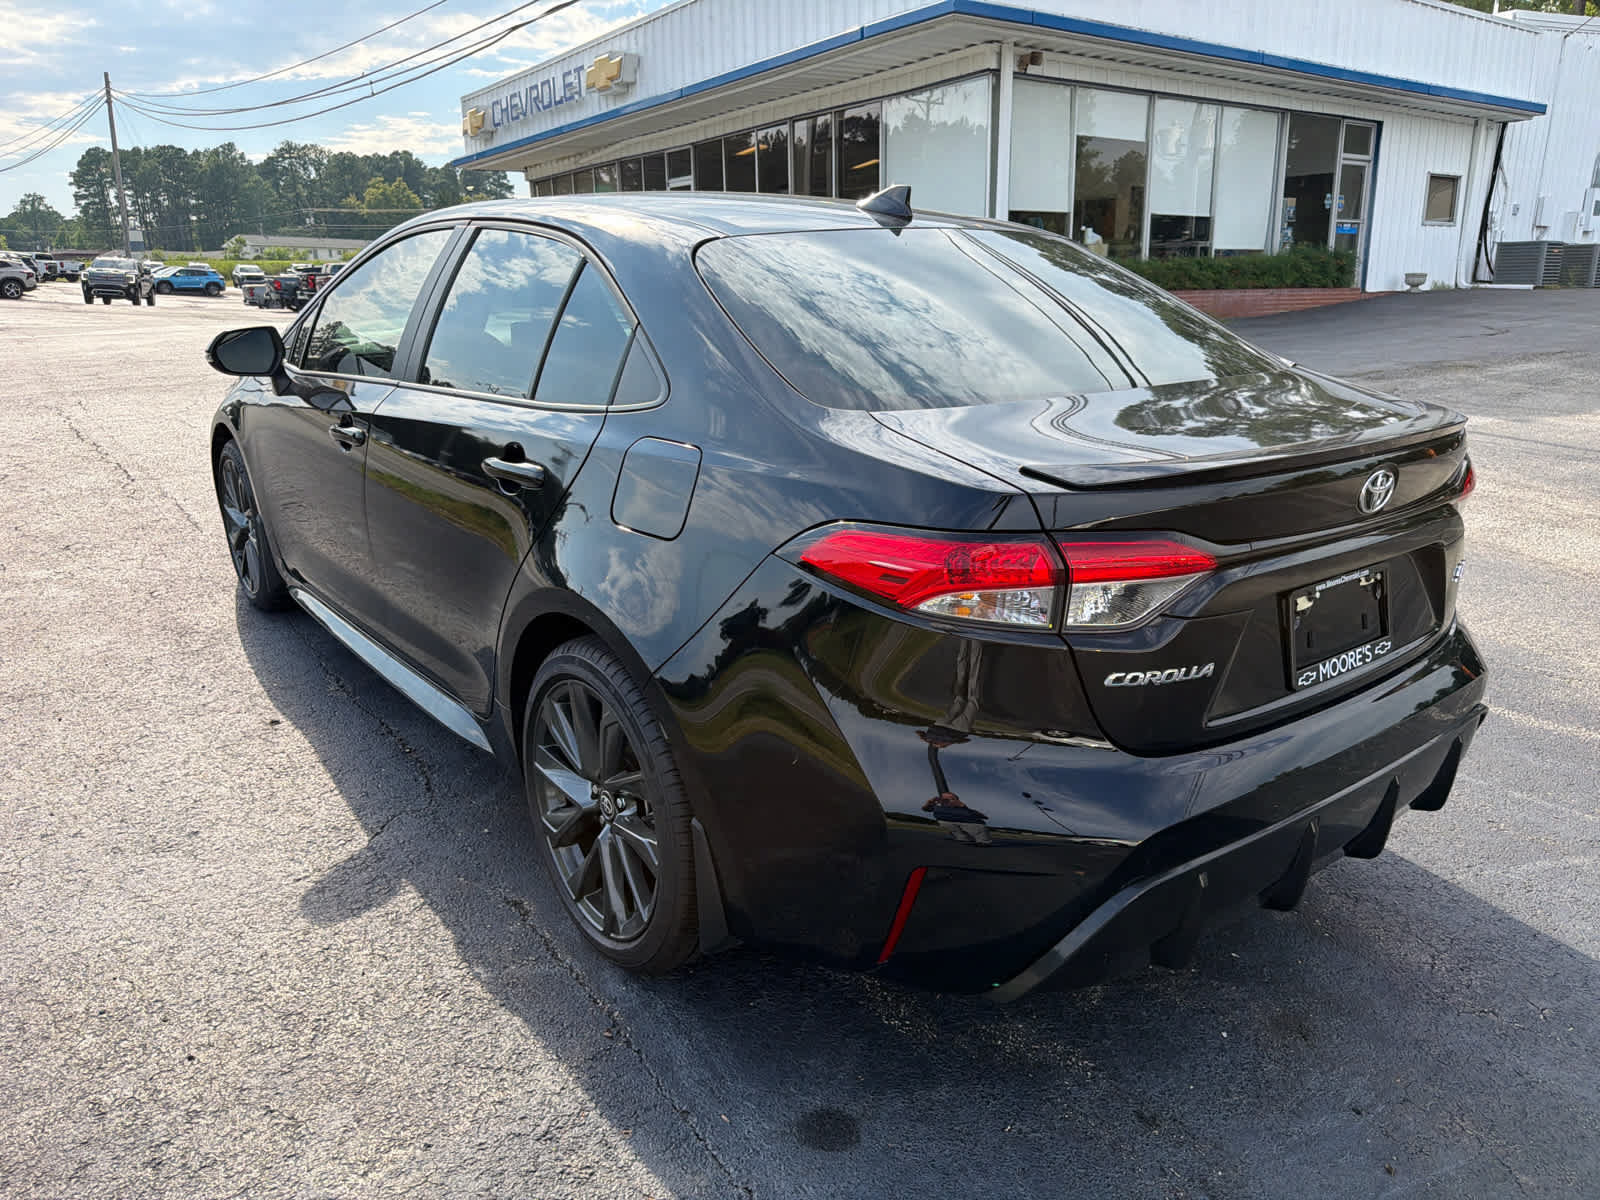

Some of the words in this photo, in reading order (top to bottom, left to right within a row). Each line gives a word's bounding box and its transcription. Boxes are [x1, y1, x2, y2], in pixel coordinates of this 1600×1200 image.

[491, 65, 585, 128] CHEVROLET
[1103, 662, 1215, 687] COROLLA
[1319, 644, 1373, 682] MOORE'S
